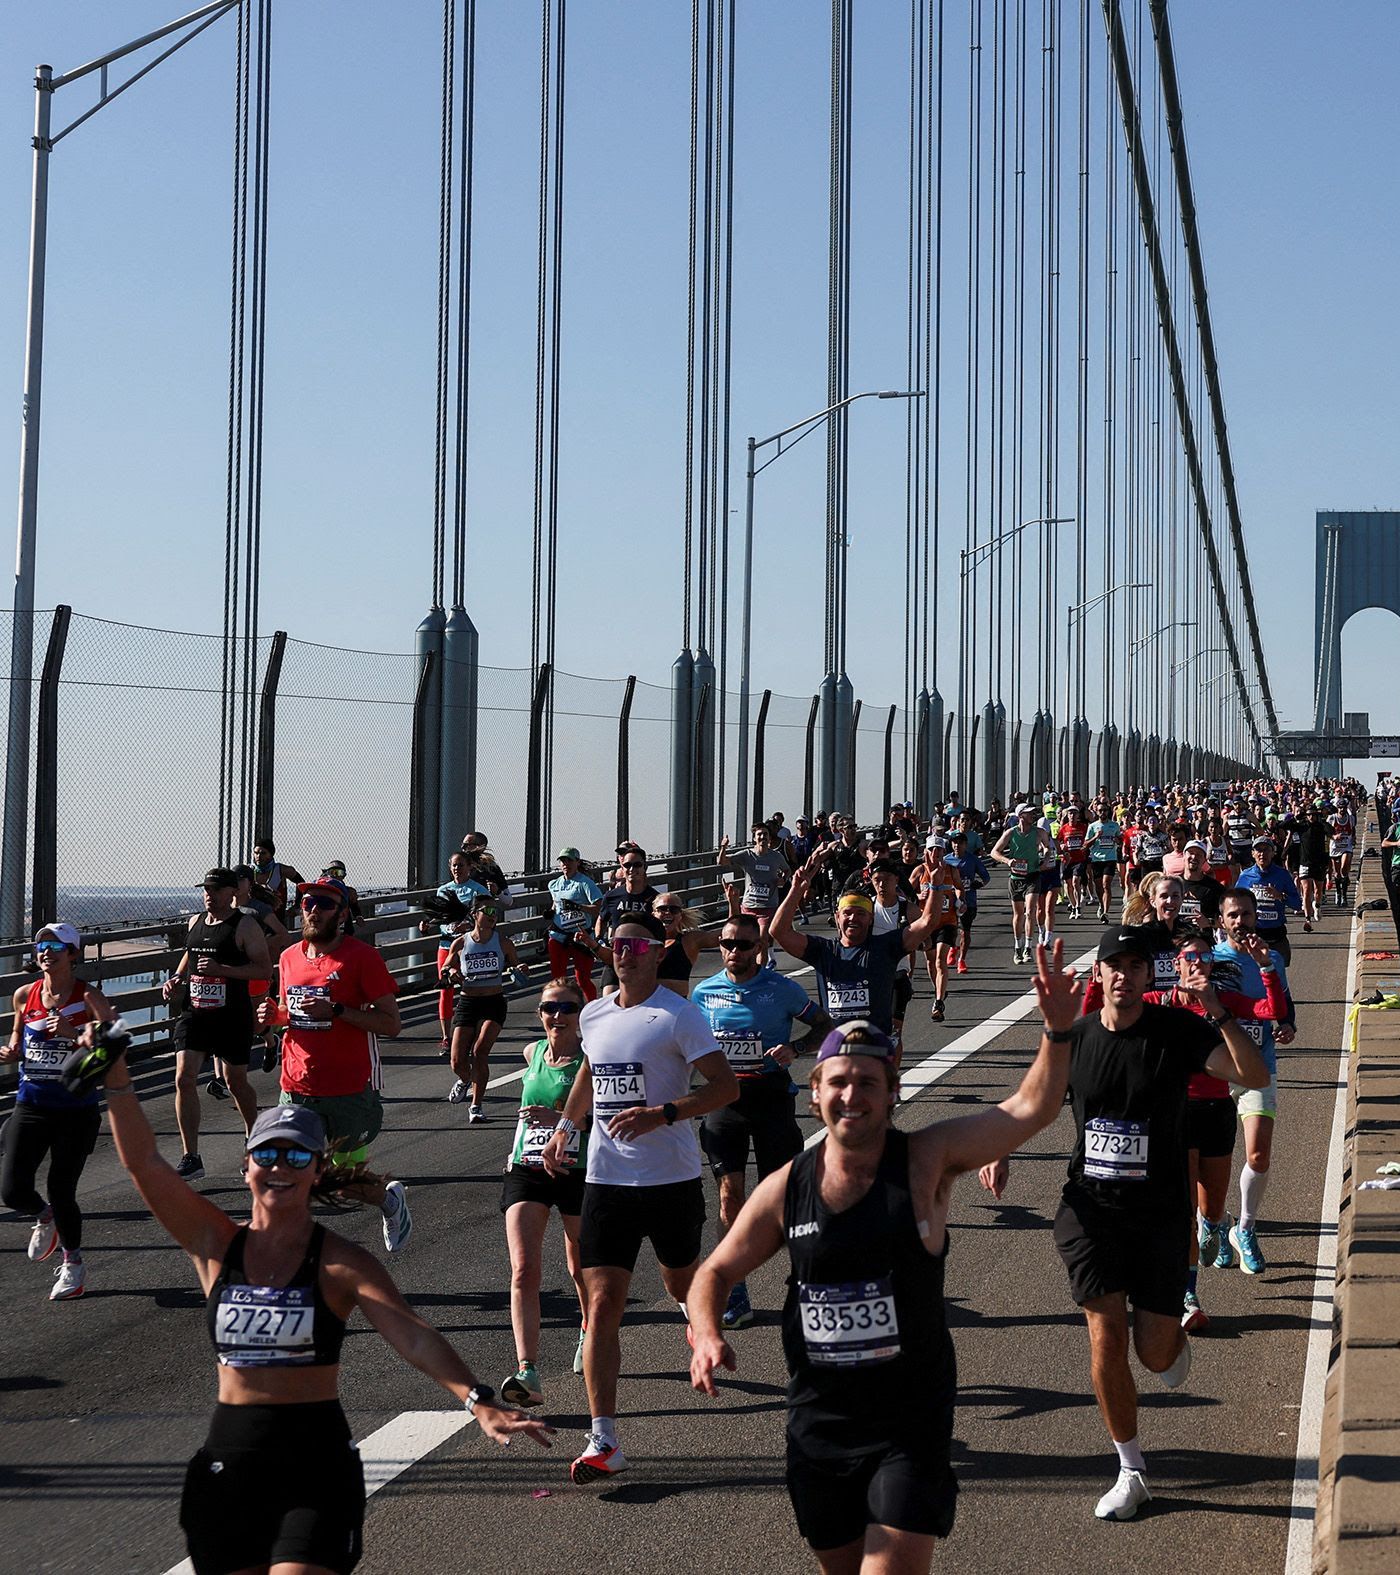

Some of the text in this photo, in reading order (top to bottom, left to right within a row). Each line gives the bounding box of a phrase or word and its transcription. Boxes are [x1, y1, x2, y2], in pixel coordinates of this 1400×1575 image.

[616, 901, 647, 912] ALEX
[467, 958, 497, 970] 26966
[192, 983, 222, 996] 30921
[830, 990, 866, 1004] 27243
[28, 1051, 68, 1066] 27257
[595, 1076, 640, 1096] 27154
[1091, 1119, 1105, 1132] tcs
[528, 1130, 577, 1146] 2687
[1091, 1133, 1141, 1156] 27321
[789, 1221, 820, 1239] HOKA
[232, 1289, 252, 1303] tcs
[808, 1289, 828, 1301] tcs
[224, 1307, 305, 1336] 27277
[807, 1300, 891, 1331] 33533
[249, 1337, 277, 1345] HELEN
